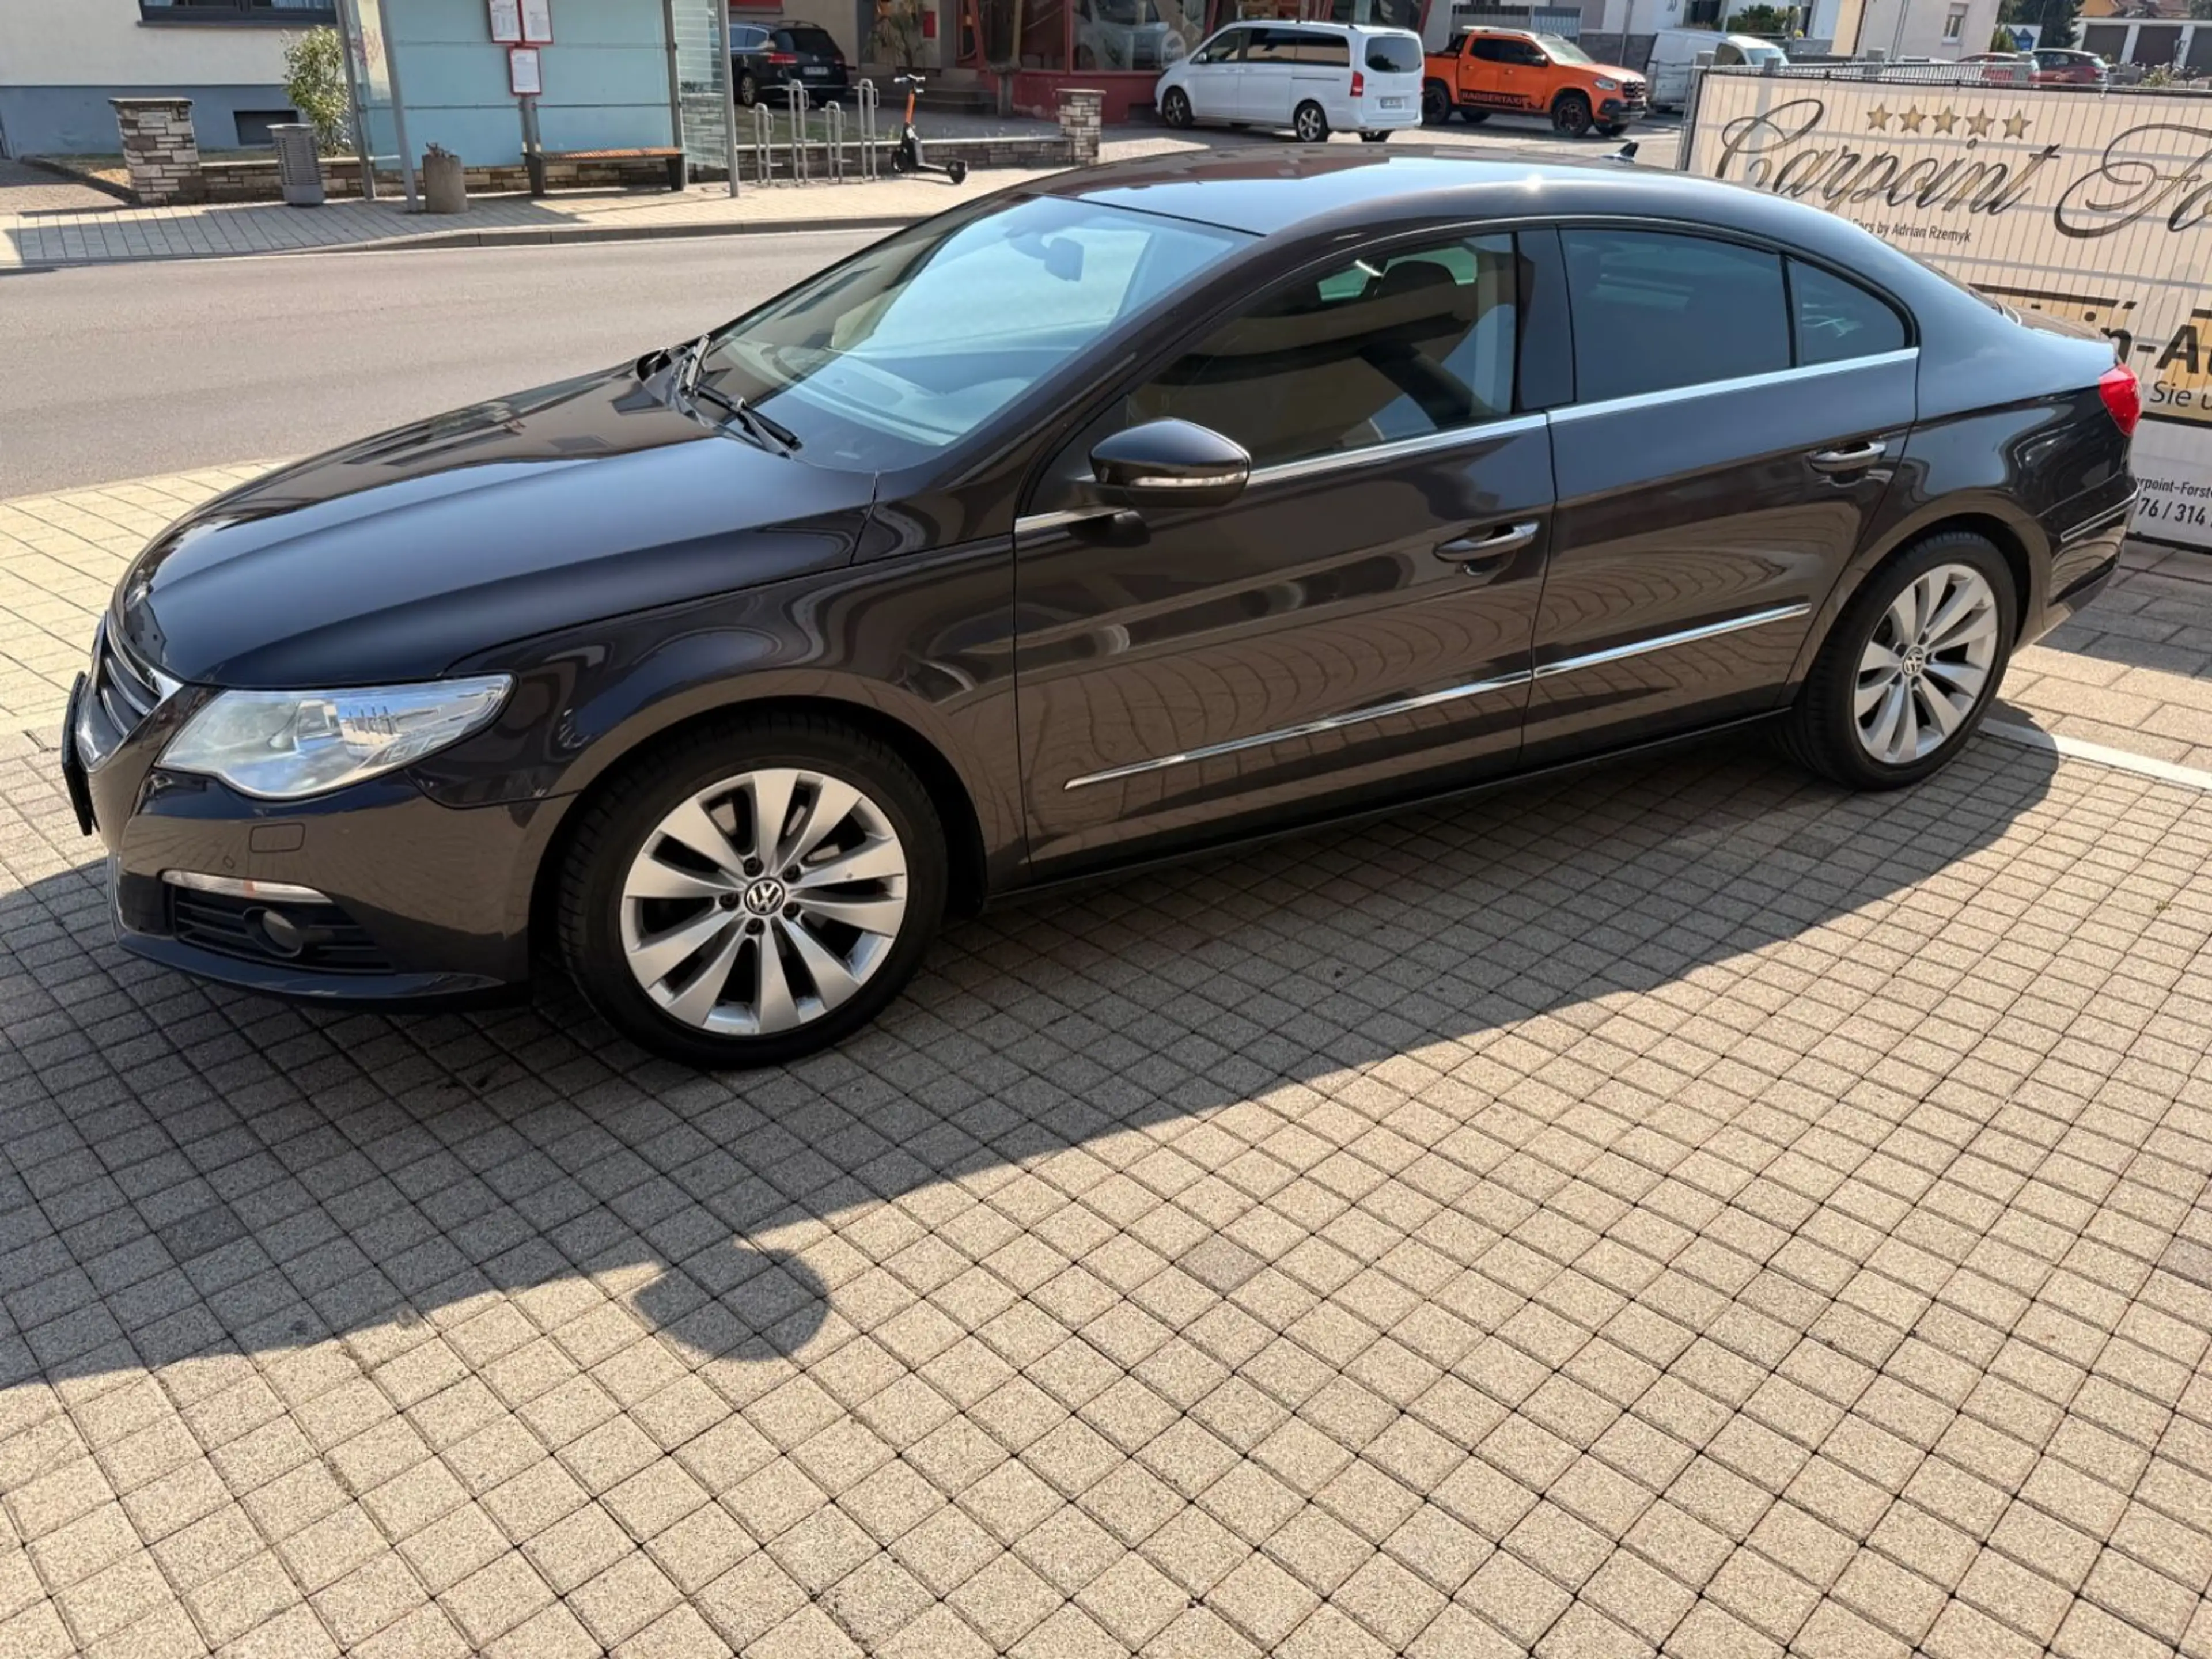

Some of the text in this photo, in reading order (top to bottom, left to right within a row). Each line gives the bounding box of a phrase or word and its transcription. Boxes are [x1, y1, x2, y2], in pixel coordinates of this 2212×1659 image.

[1714, 98, 2061, 216] Carpoint
[1877, 221, 1889, 238] by
[1891, 221, 1926, 238] Adrian
[1928, 225, 1972, 245] Rzemyk
[2149, 380, 2191, 407] Sie
[2137, 477, 2212, 499] rpoint-Forst
[2139, 497, 2159, 517] 76
[2161, 501, 2173, 520] /
[2174, 503, 2206, 526] 314
[745, 878, 784, 915] VW
